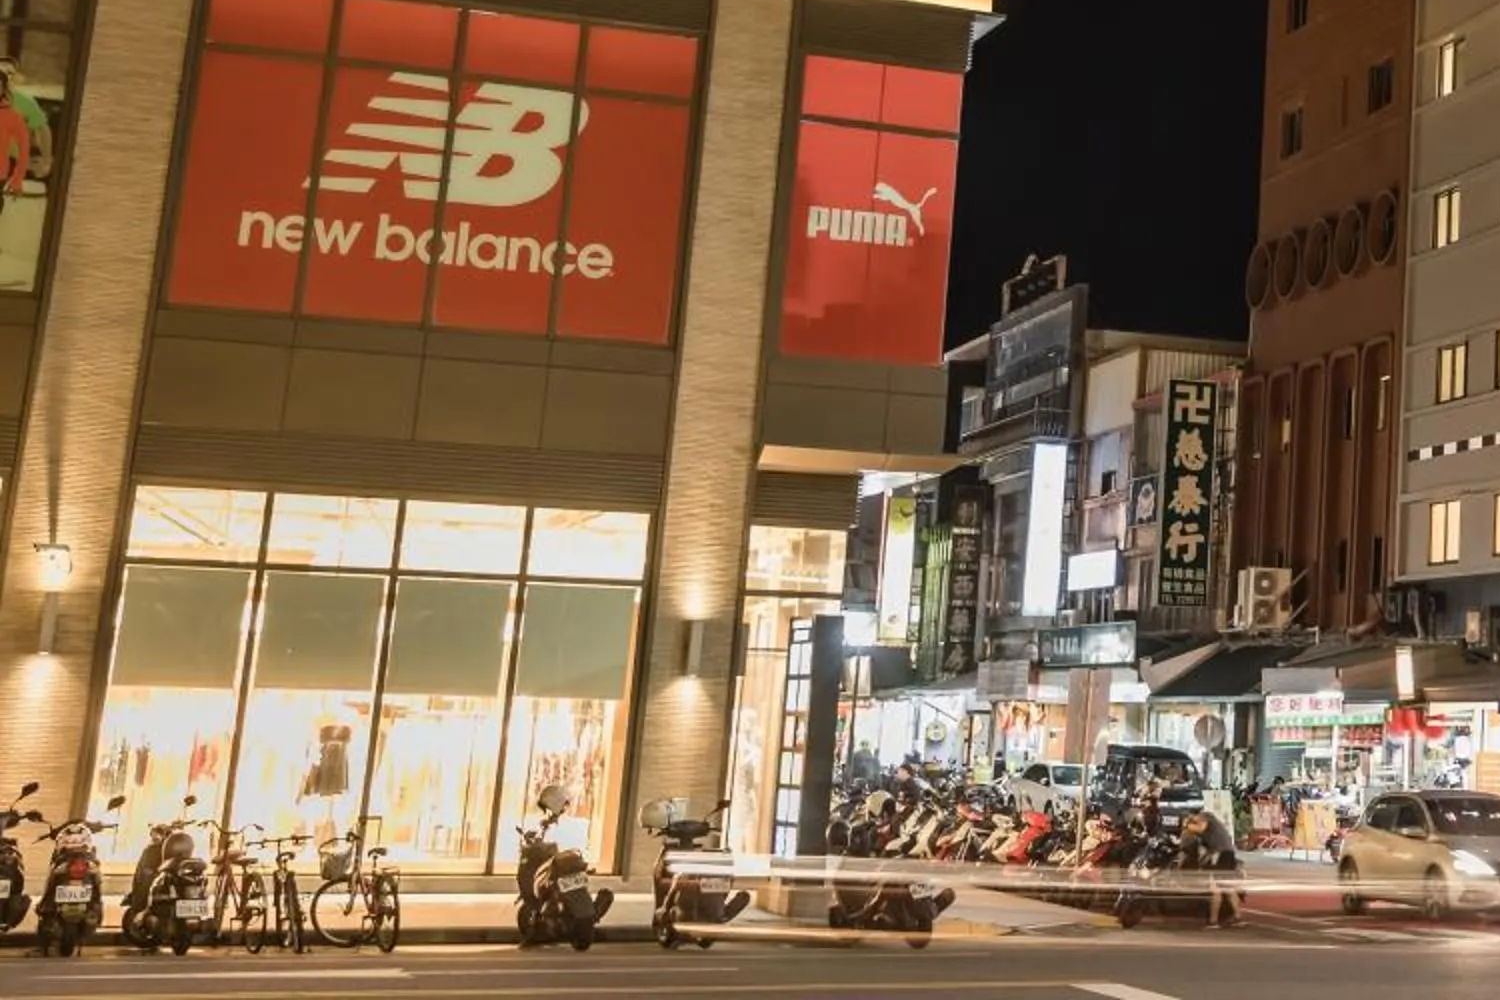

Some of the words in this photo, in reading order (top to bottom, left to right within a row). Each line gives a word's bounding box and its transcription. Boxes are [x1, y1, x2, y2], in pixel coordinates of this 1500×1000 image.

[237, 208, 363, 256] new
[375, 212, 614, 278] balance
[807, 206, 907, 247] PUMA
